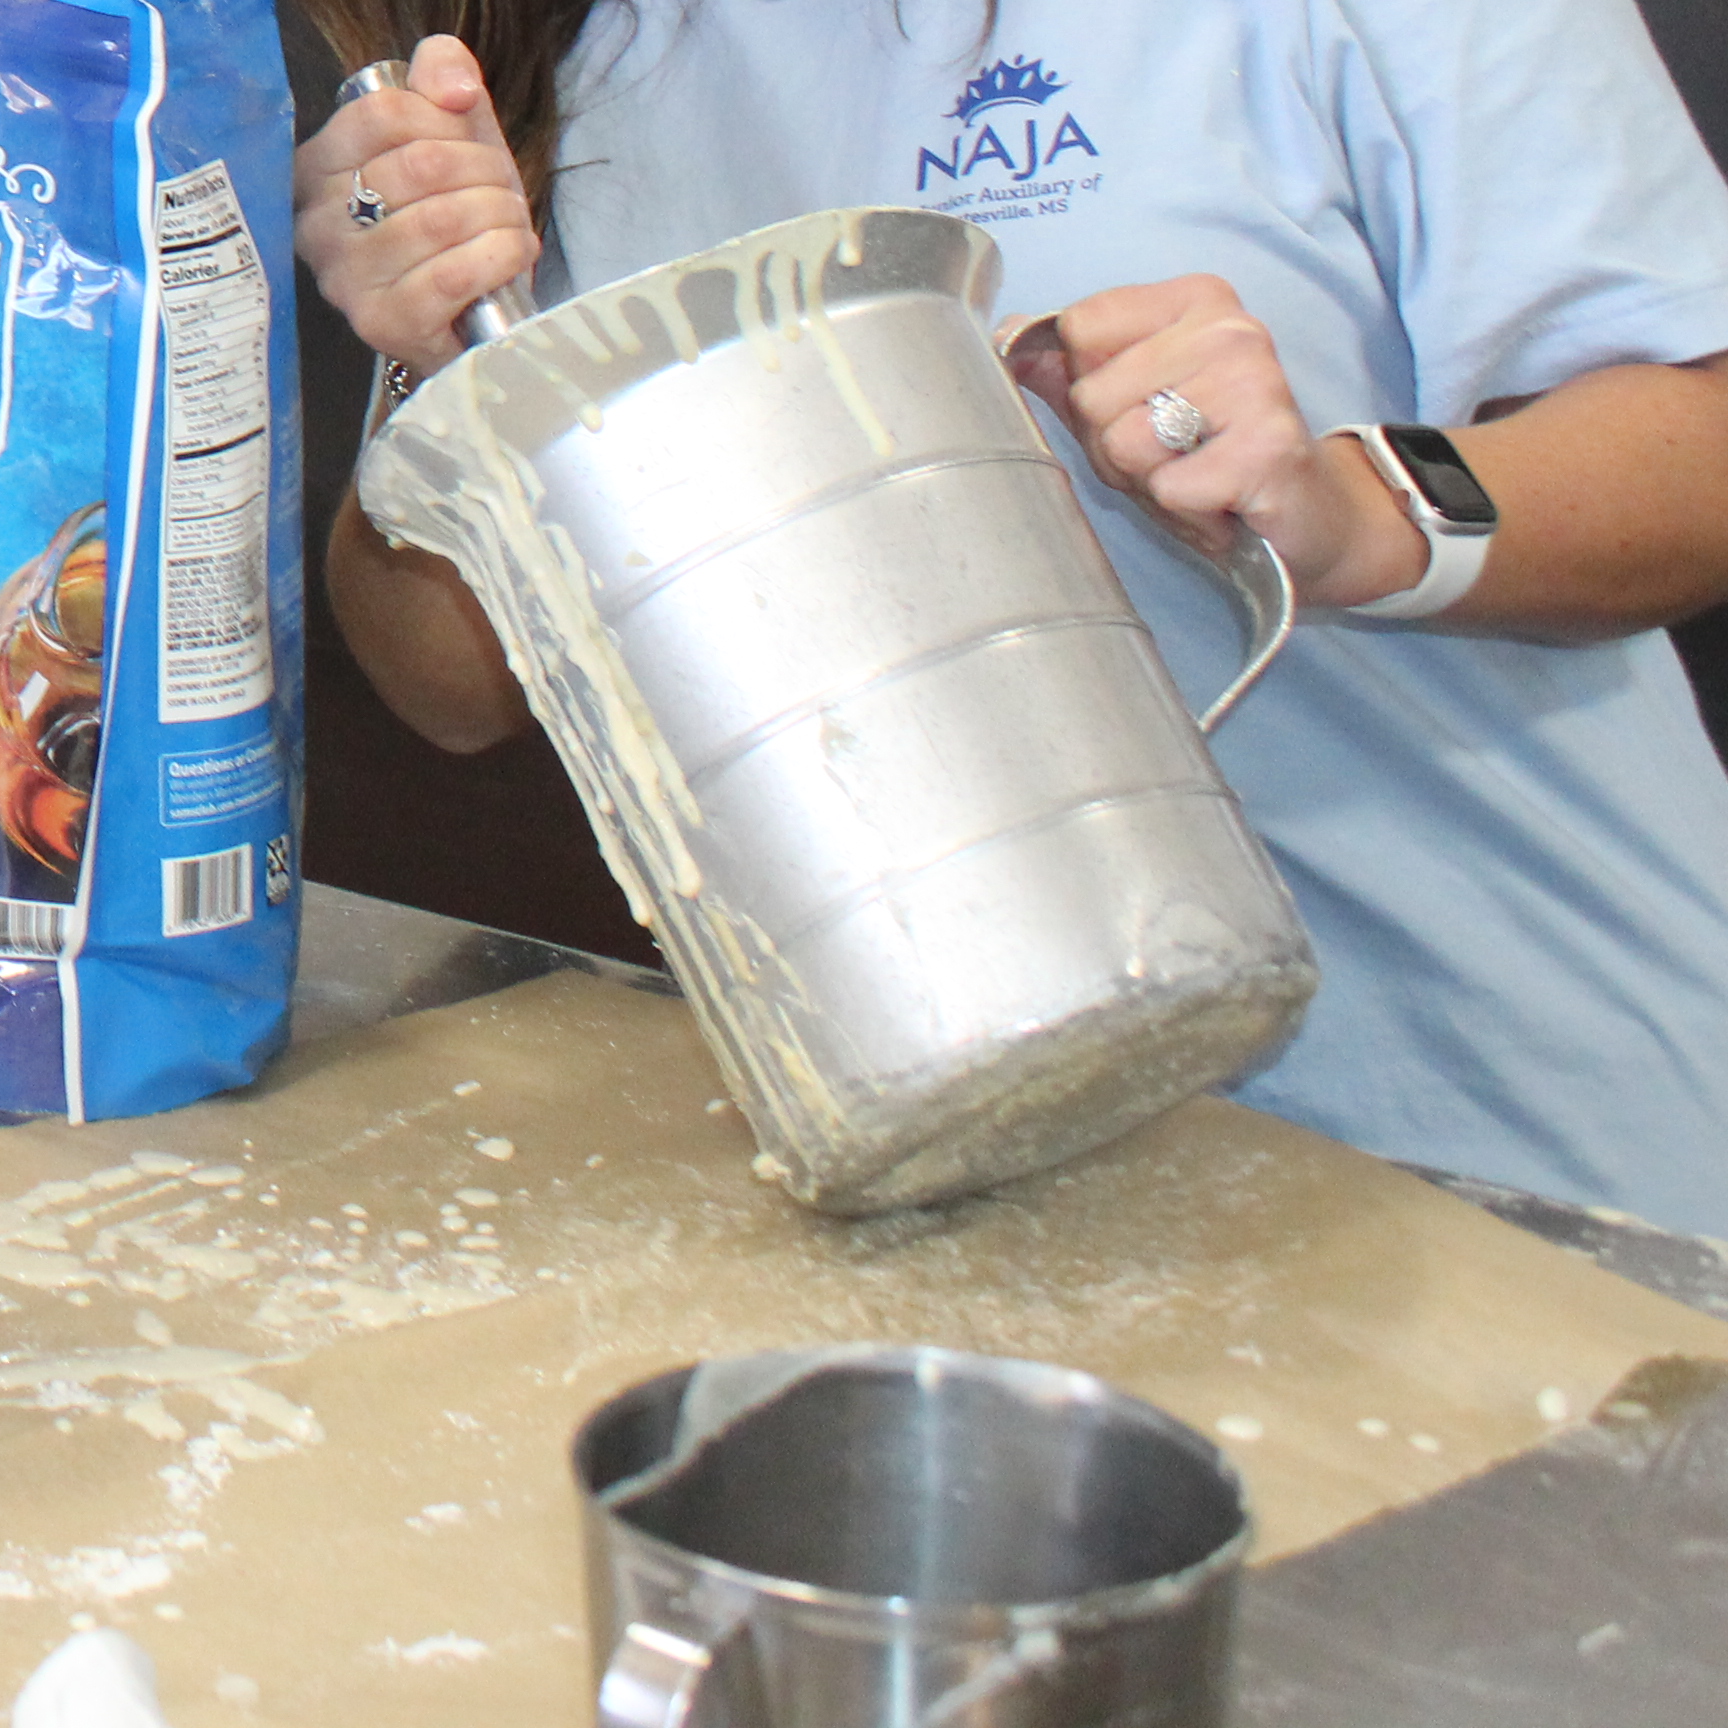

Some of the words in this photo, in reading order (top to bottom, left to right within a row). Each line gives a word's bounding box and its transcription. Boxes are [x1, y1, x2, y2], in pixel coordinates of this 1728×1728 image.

[915, 111, 1100, 192] NAJA
[979, 178, 1074, 203] Auxiliary
[1080, 173, 1104, 192] of
[1038, 198, 1069, 215] MS
[161, 263, 221, 285] Calories
[169, 758, 235, 779] Questions
